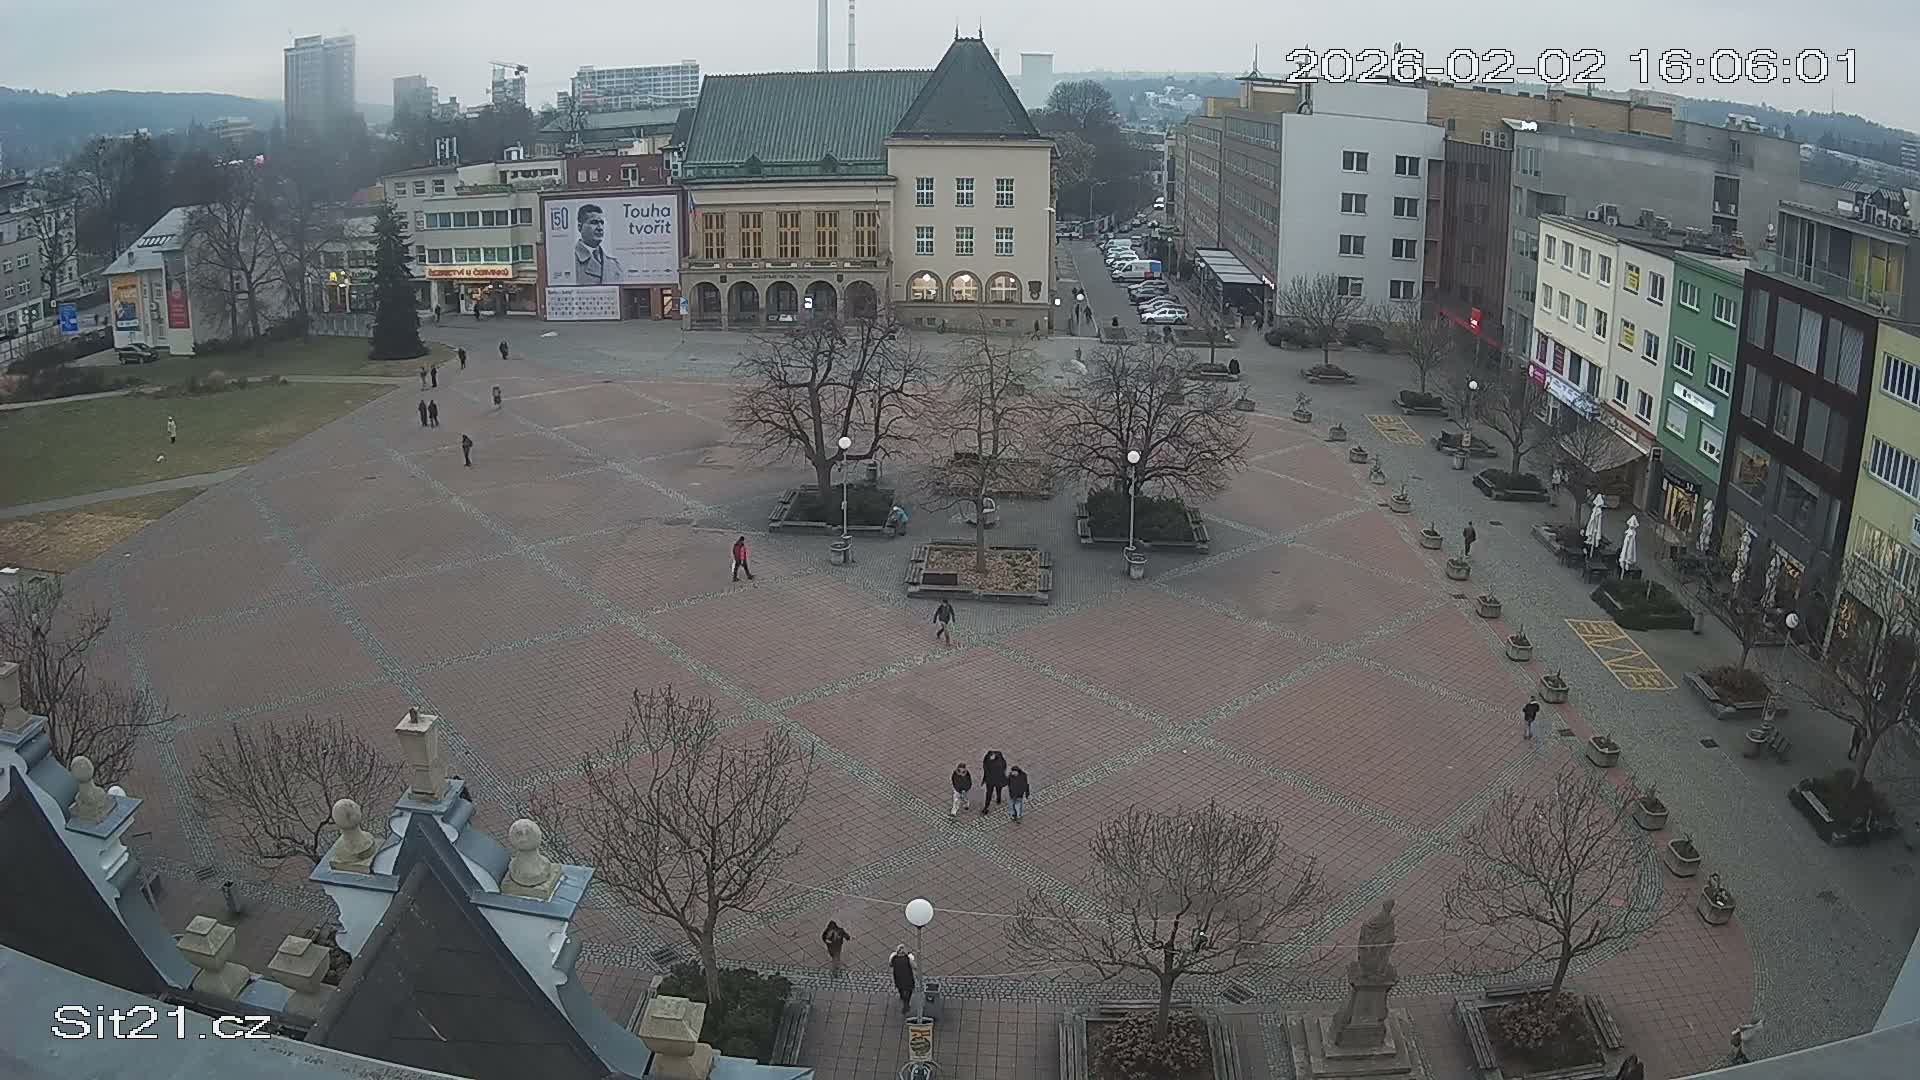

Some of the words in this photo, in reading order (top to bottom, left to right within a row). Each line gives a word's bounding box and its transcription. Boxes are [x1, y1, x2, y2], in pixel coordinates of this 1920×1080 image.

[623, 203, 671, 218] Touha
[551, 206, 569, 231] 150
[629, 220, 671, 235] tvořit
